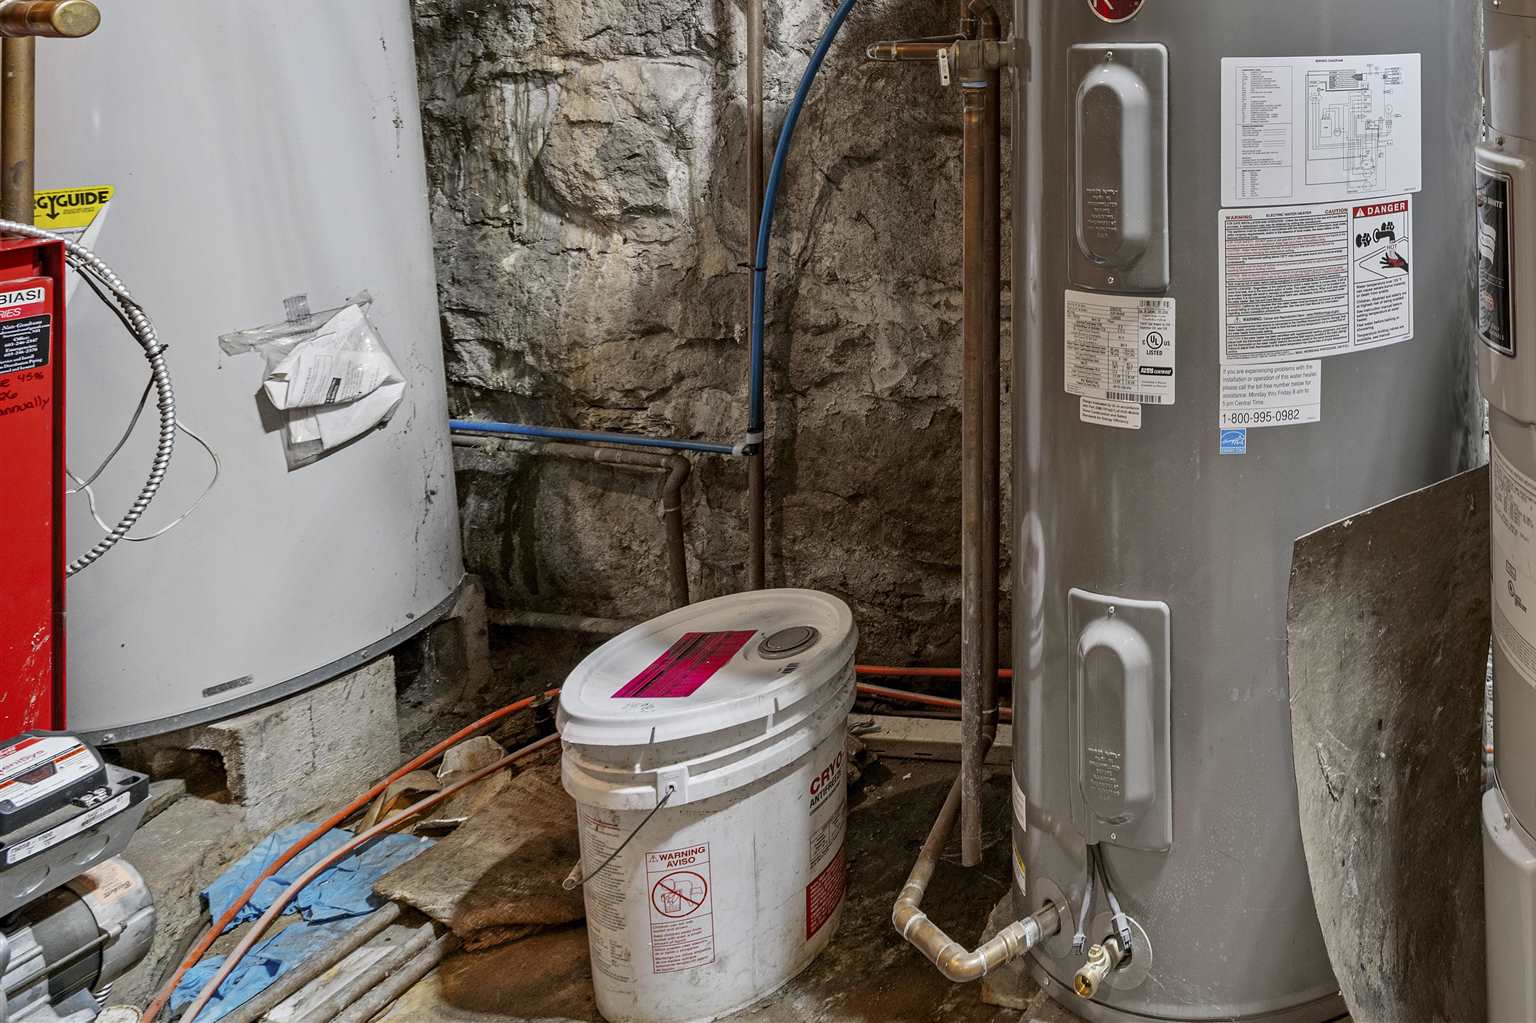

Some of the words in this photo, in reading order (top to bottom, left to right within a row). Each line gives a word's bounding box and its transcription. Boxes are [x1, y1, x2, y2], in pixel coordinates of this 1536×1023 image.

[1367, 202, 1406, 216] DANGER
[1150, 335, 1159, 346] UL
[1222, 409, 1300, 424] 1-800-995-0982
[659, 846, 706, 862] WARNING
[667, 856, 696, 868] AVISO
